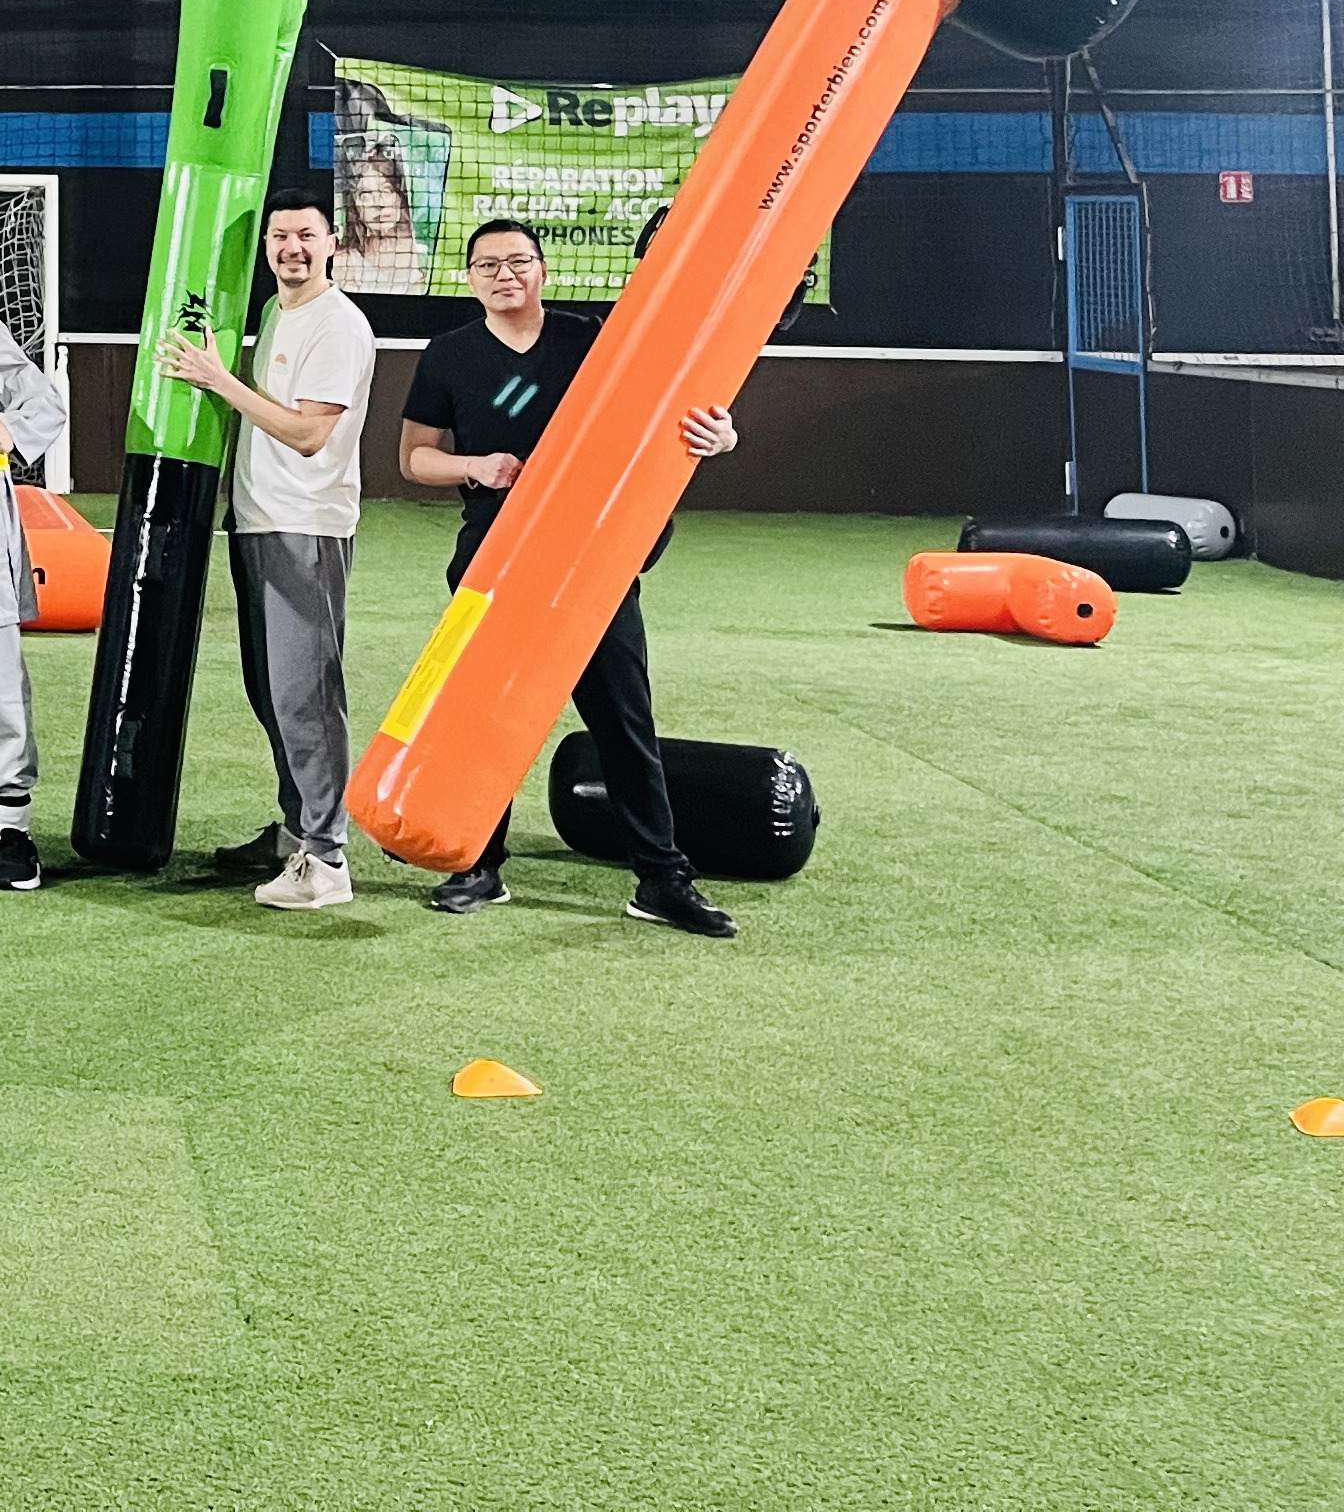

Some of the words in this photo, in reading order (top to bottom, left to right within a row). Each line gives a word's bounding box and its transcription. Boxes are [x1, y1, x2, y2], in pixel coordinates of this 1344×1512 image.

[546, 87, 727, 138] Replay
[492, 158, 664, 193] RÉPARATION
[473, 194, 584, 221] RACHAT
[525, 219, 635, 246] PHONES
